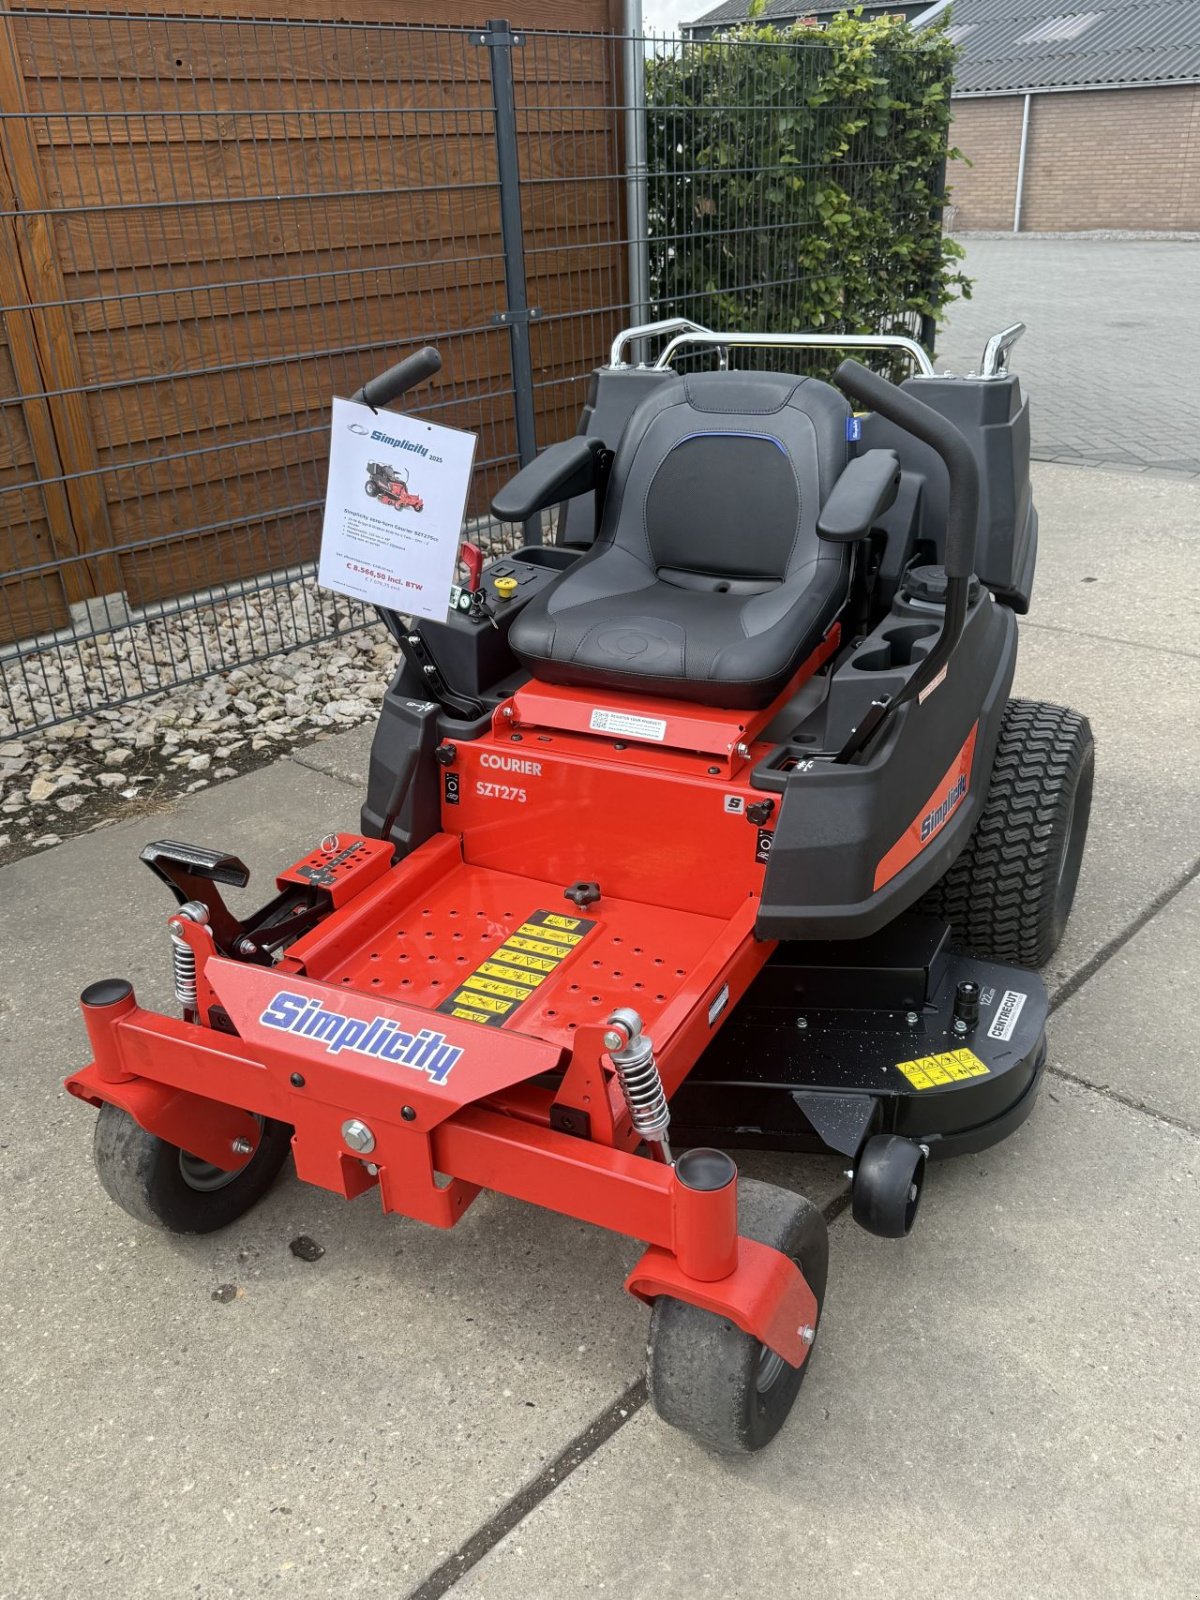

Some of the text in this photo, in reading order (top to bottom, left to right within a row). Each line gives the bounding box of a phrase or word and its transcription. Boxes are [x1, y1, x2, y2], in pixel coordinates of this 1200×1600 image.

[370, 430, 443, 463] Simplicity 2025
[353, 564, 386, 580] 8.566,50
[405, 580, 423, 591] BTW
[479, 753, 542, 777] COURIER
[476, 781, 527, 803] SZT275
[921, 774, 967, 842] Simplicity
[991, 991, 1018, 1037] CENTRECUT
[260, 992, 464, 1084] Simplicity
